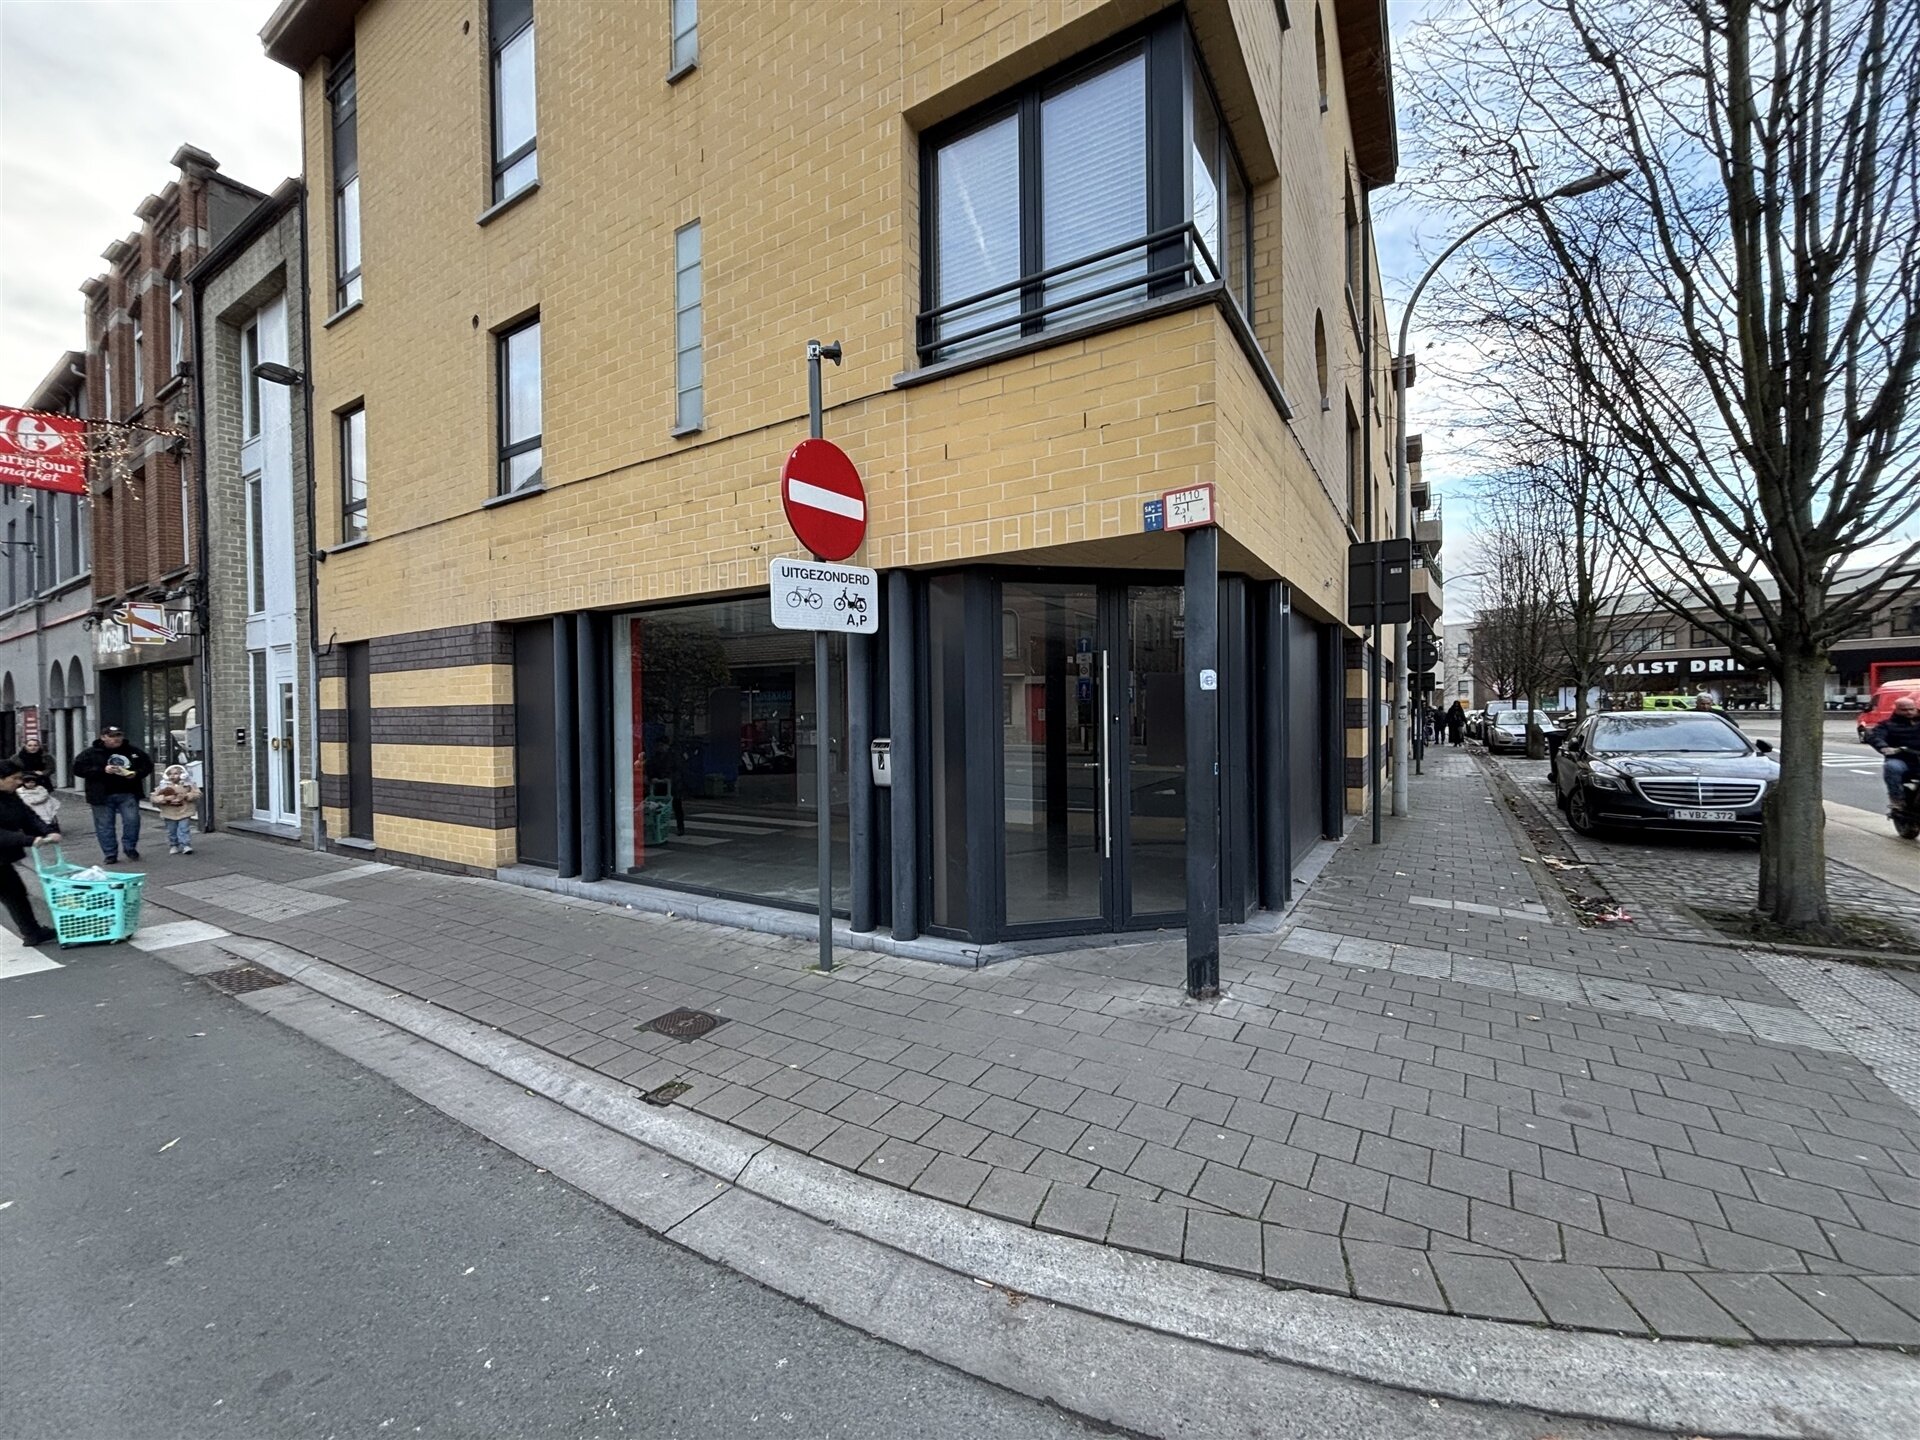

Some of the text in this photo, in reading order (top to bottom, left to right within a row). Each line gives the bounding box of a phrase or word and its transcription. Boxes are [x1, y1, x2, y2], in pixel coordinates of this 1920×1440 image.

[0, 466, 61, 482] market
[1174, 489, 1200, 503] H110
[781, 566, 870, 586] UITGEZONDERD
[846, 613, 868, 627] A,P
[1604, 661, 1678, 675] AALST
[1675, 810, 1734, 820] 1-VBZ-372
